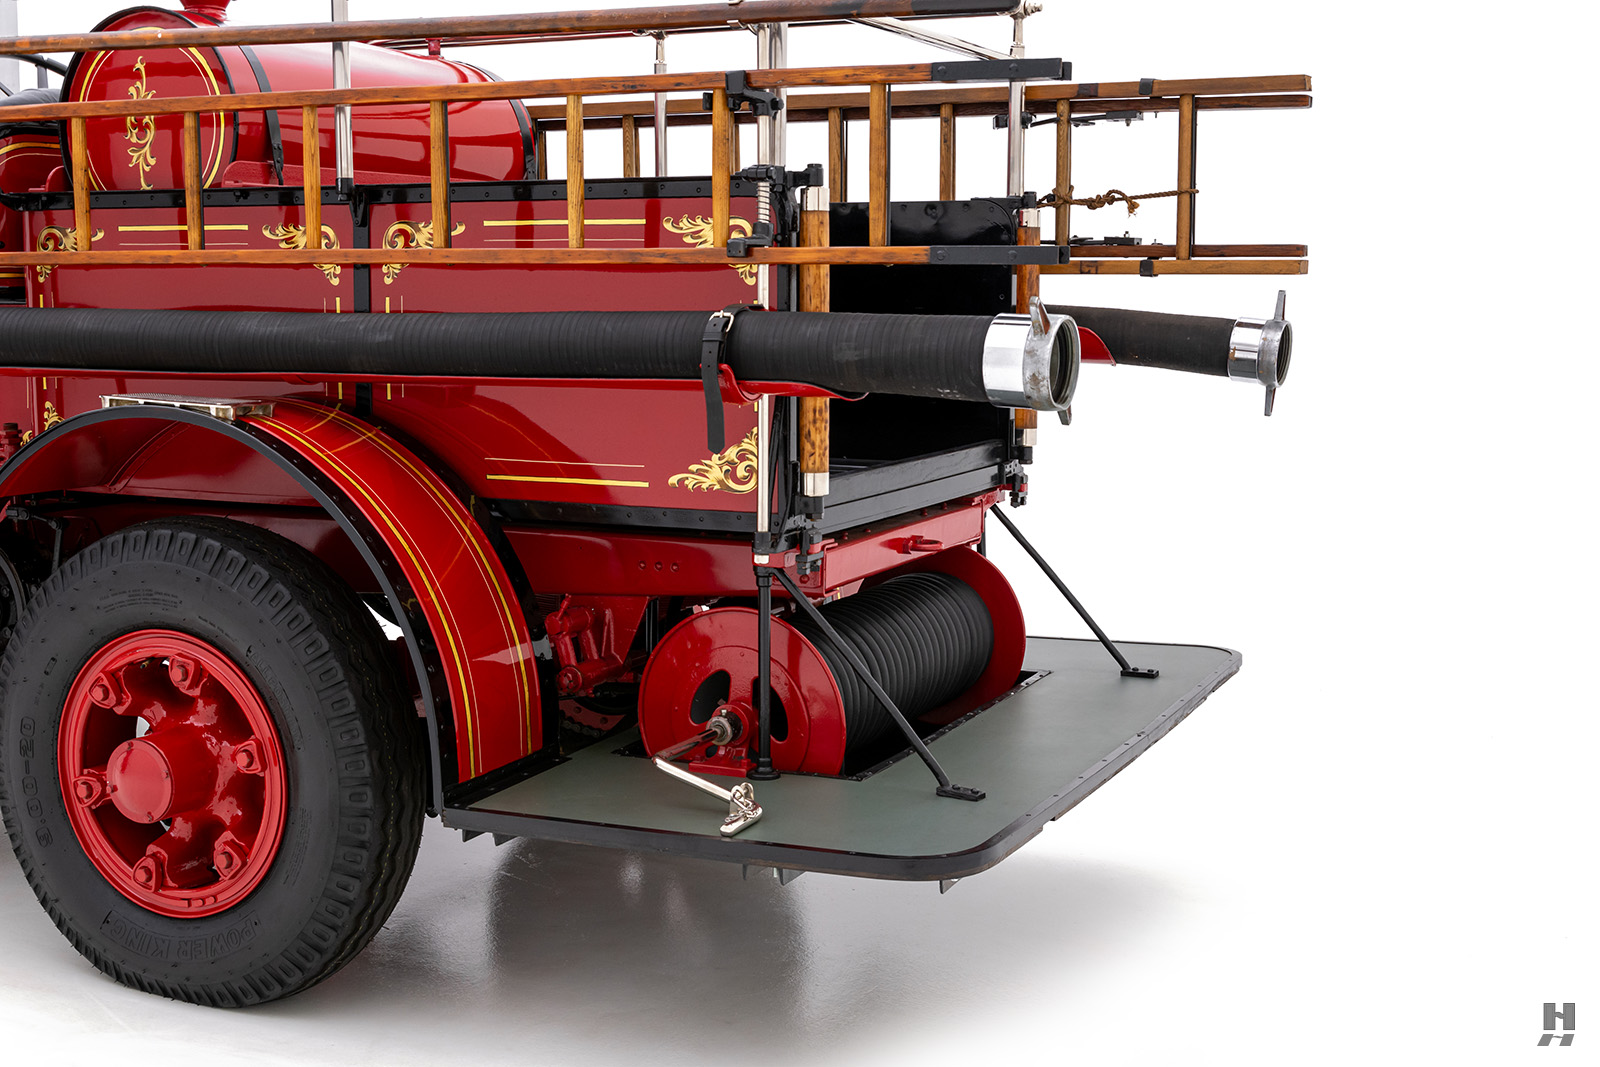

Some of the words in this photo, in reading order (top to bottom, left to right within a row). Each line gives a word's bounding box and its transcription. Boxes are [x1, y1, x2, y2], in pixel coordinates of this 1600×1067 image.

[19, 716, 53, 848] 9.00-20
[110, 918, 171, 959] KING
[177, 918, 257, 961] POWER
